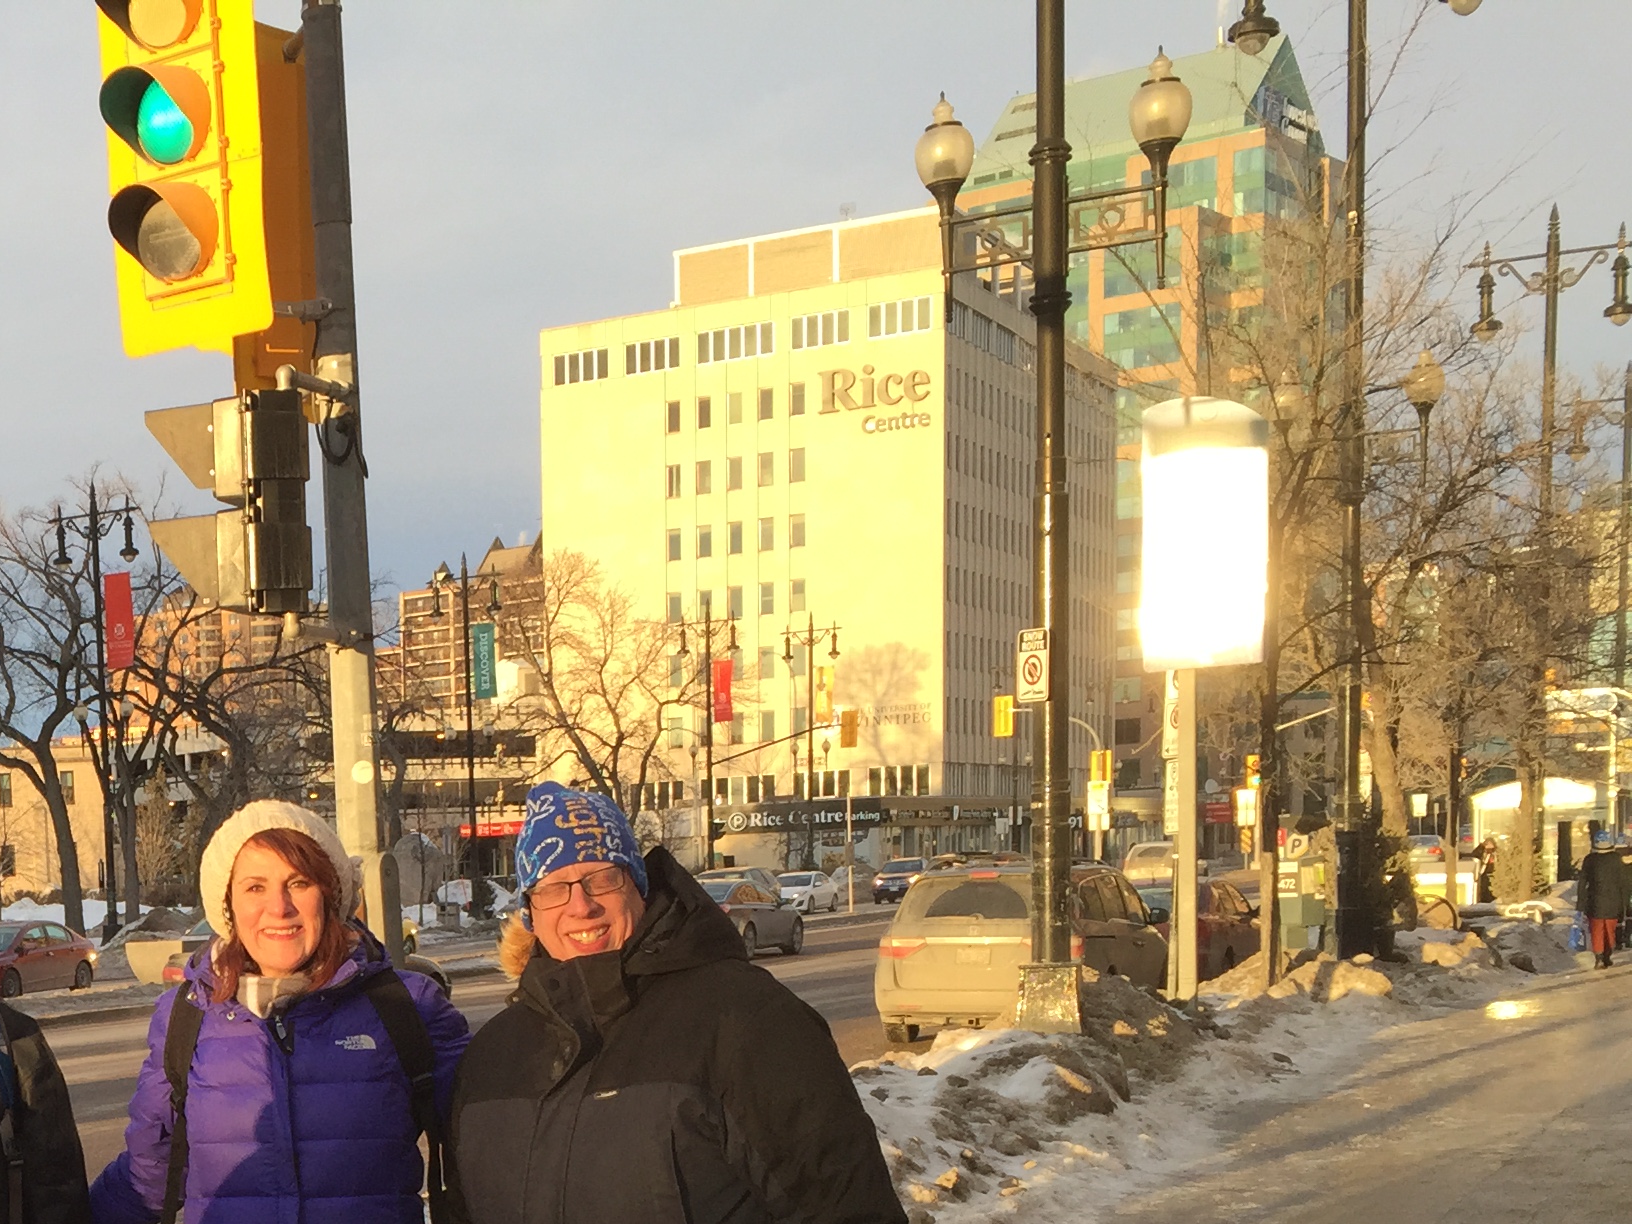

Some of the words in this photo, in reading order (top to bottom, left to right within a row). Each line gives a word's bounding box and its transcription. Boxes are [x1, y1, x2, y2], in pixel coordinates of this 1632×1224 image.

[817, 364, 931, 415] Rice
[861, 412, 931, 434] Centre
[479, 632, 491, 691] DISCOVER
[749, 810, 784, 828] Rice
